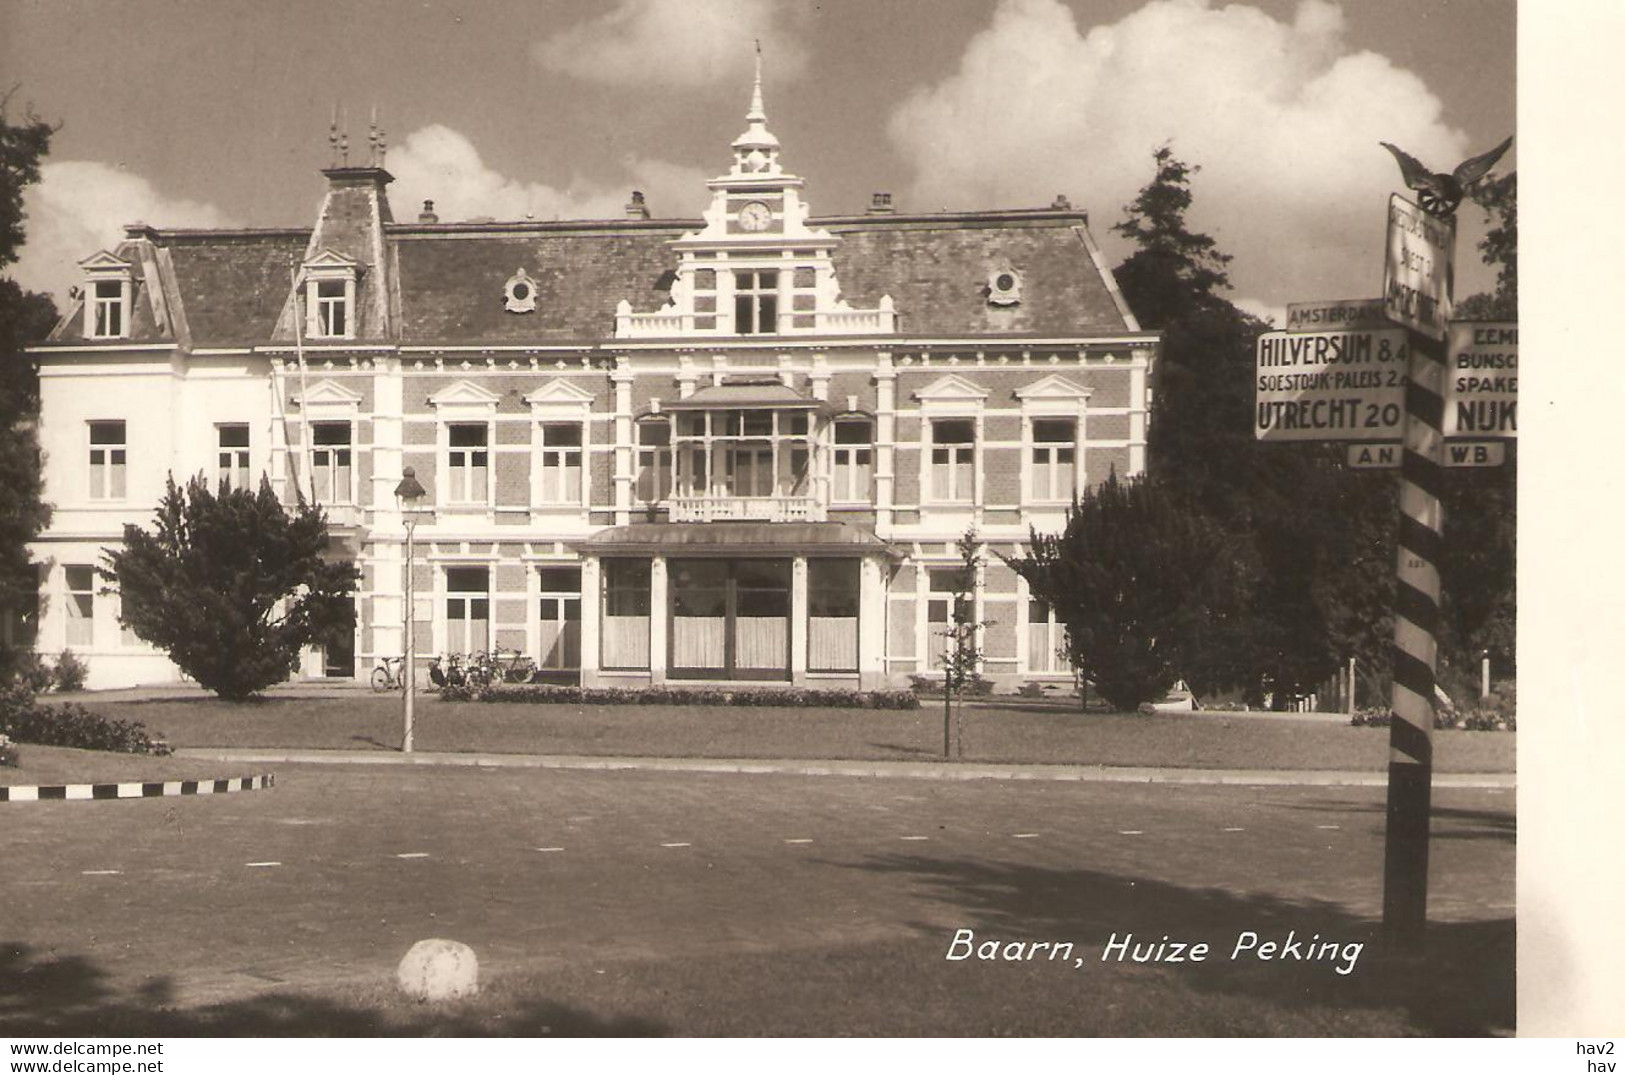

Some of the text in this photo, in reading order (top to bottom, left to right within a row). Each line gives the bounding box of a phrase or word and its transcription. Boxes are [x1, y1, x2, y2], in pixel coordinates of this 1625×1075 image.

[1260, 334, 1372, 367] HILVERSUM
[1258, 399, 1400, 430] UTRECHT 20
